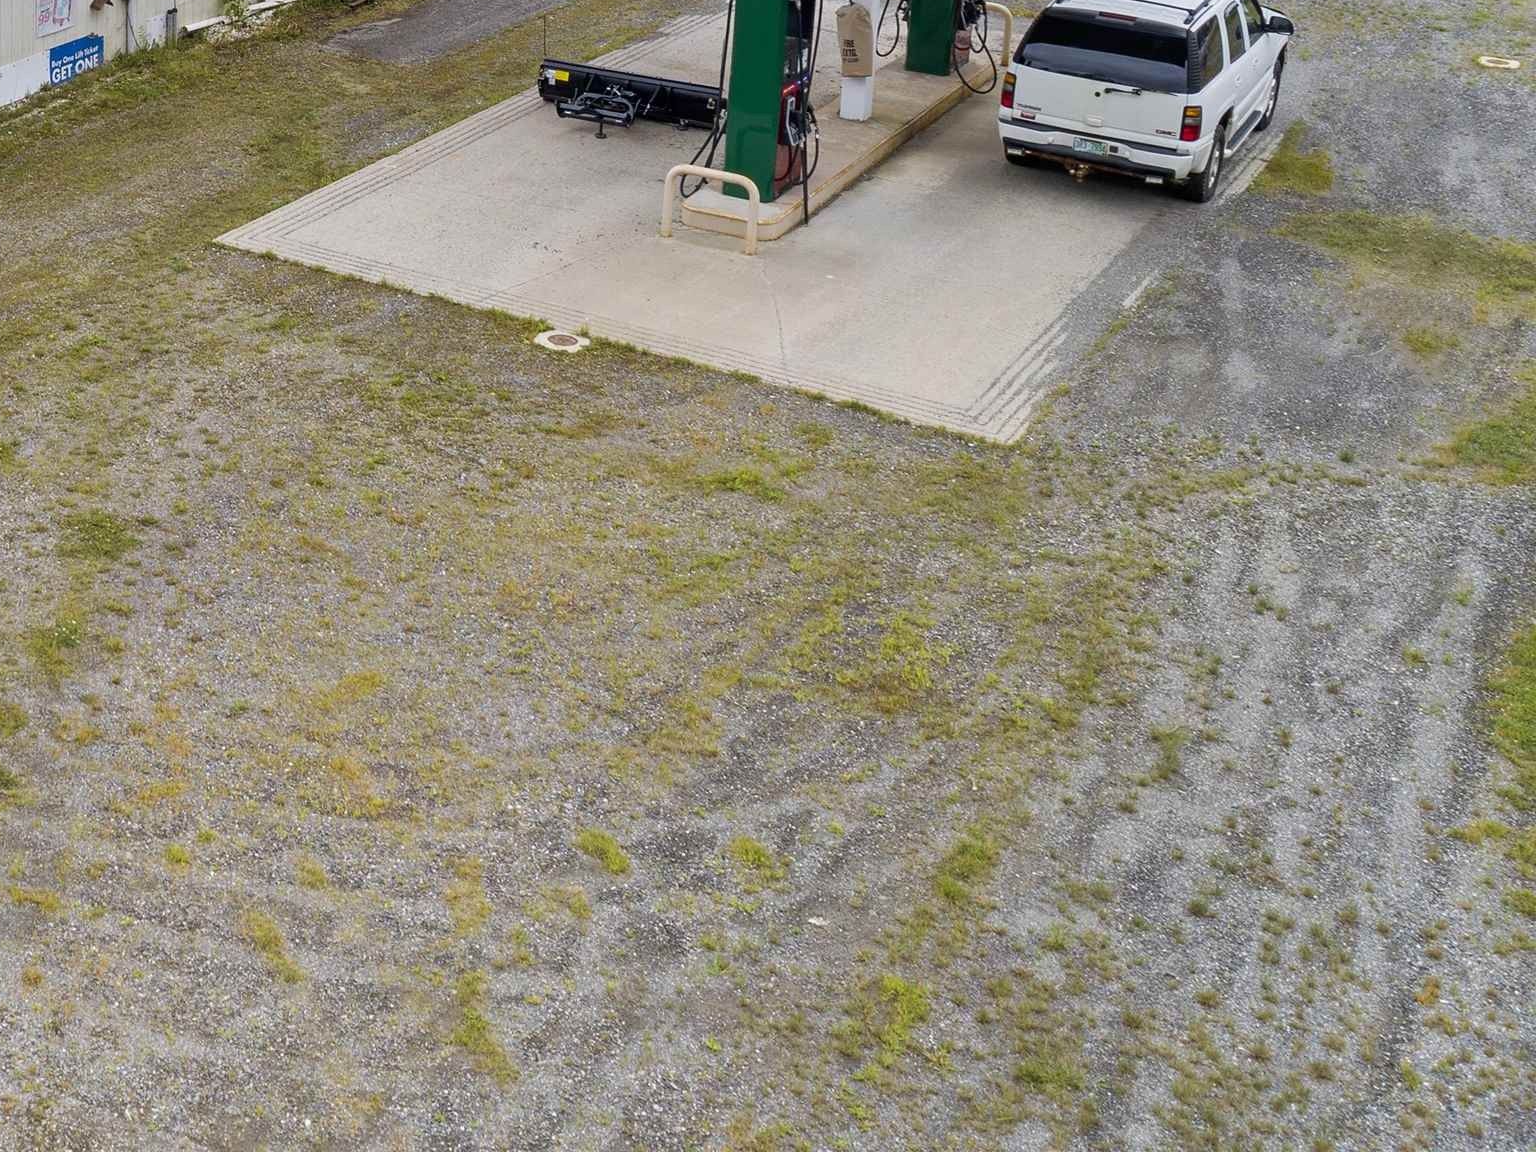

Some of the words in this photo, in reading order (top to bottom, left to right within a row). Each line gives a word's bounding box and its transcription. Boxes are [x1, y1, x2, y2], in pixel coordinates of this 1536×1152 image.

[51, 59, 62, 68] Buy
[62, 55, 74, 64] One
[84, 45, 99, 56] Ticket
[52, 63, 72, 83] GET
[75, 53, 99, 74] ONE
